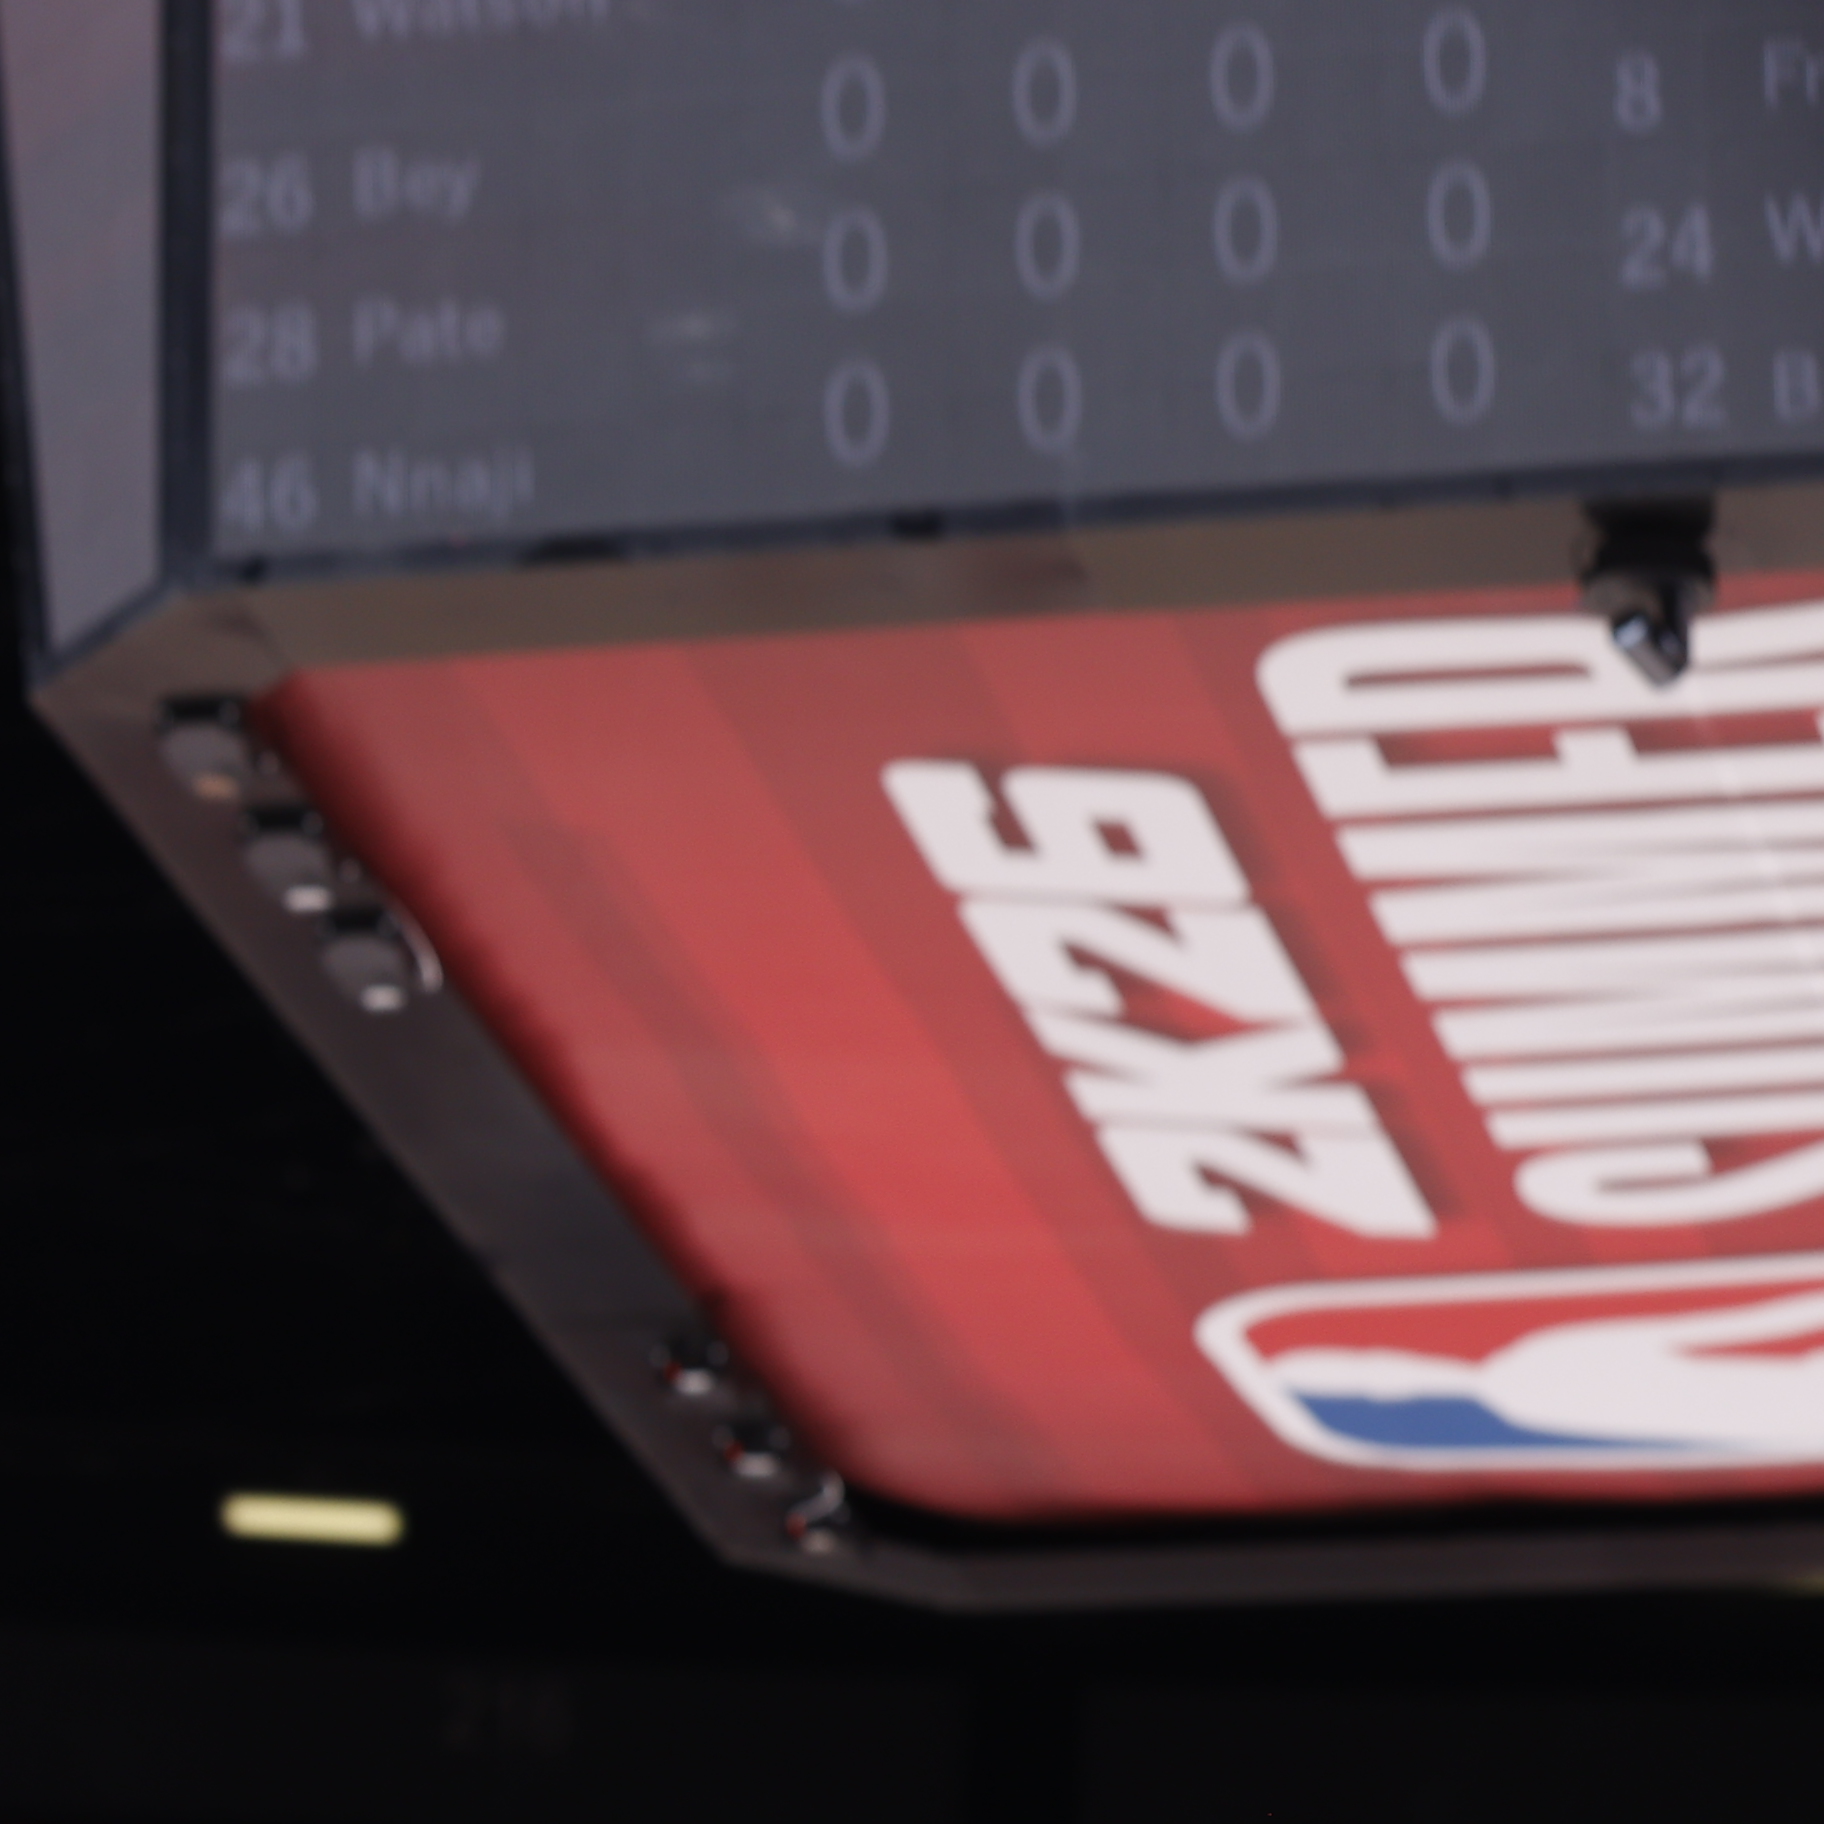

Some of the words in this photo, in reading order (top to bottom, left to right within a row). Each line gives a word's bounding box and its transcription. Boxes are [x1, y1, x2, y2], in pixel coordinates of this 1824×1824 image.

[220, 0, 307, 62] 21
[1612, 48, 1663, 135] 8
[221, 152, 314, 238] 26
[354, 145, 482, 227] Bey
[819, 53, 887, 163] 0
[1011, 36, 1079, 148] 0
[1209, 20, 1275, 133] 0
[1421, 5, 1487, 118] 0
[221, 302, 318, 388] 28
[355, 298, 504, 366] Pate
[822, 207, 889, 315] 0
[1014, 190, 1081, 301] 0
[1212, 173, 1279, 287] 0
[1425, 155, 1493, 272] 0
[1617, 203, 1716, 291] 24
[221, 452, 318, 532] 46
[354, 445, 534, 526] Nnaji
[824, 357, 891, 468] 0
[1016, 343, 1083, 456] 0
[1215, 330, 1282, 442] 0
[1430, 312, 1497, 427] 0
[1629, 343, 1728, 431] 32
[880, 758, 1439, 1239] 2K26
